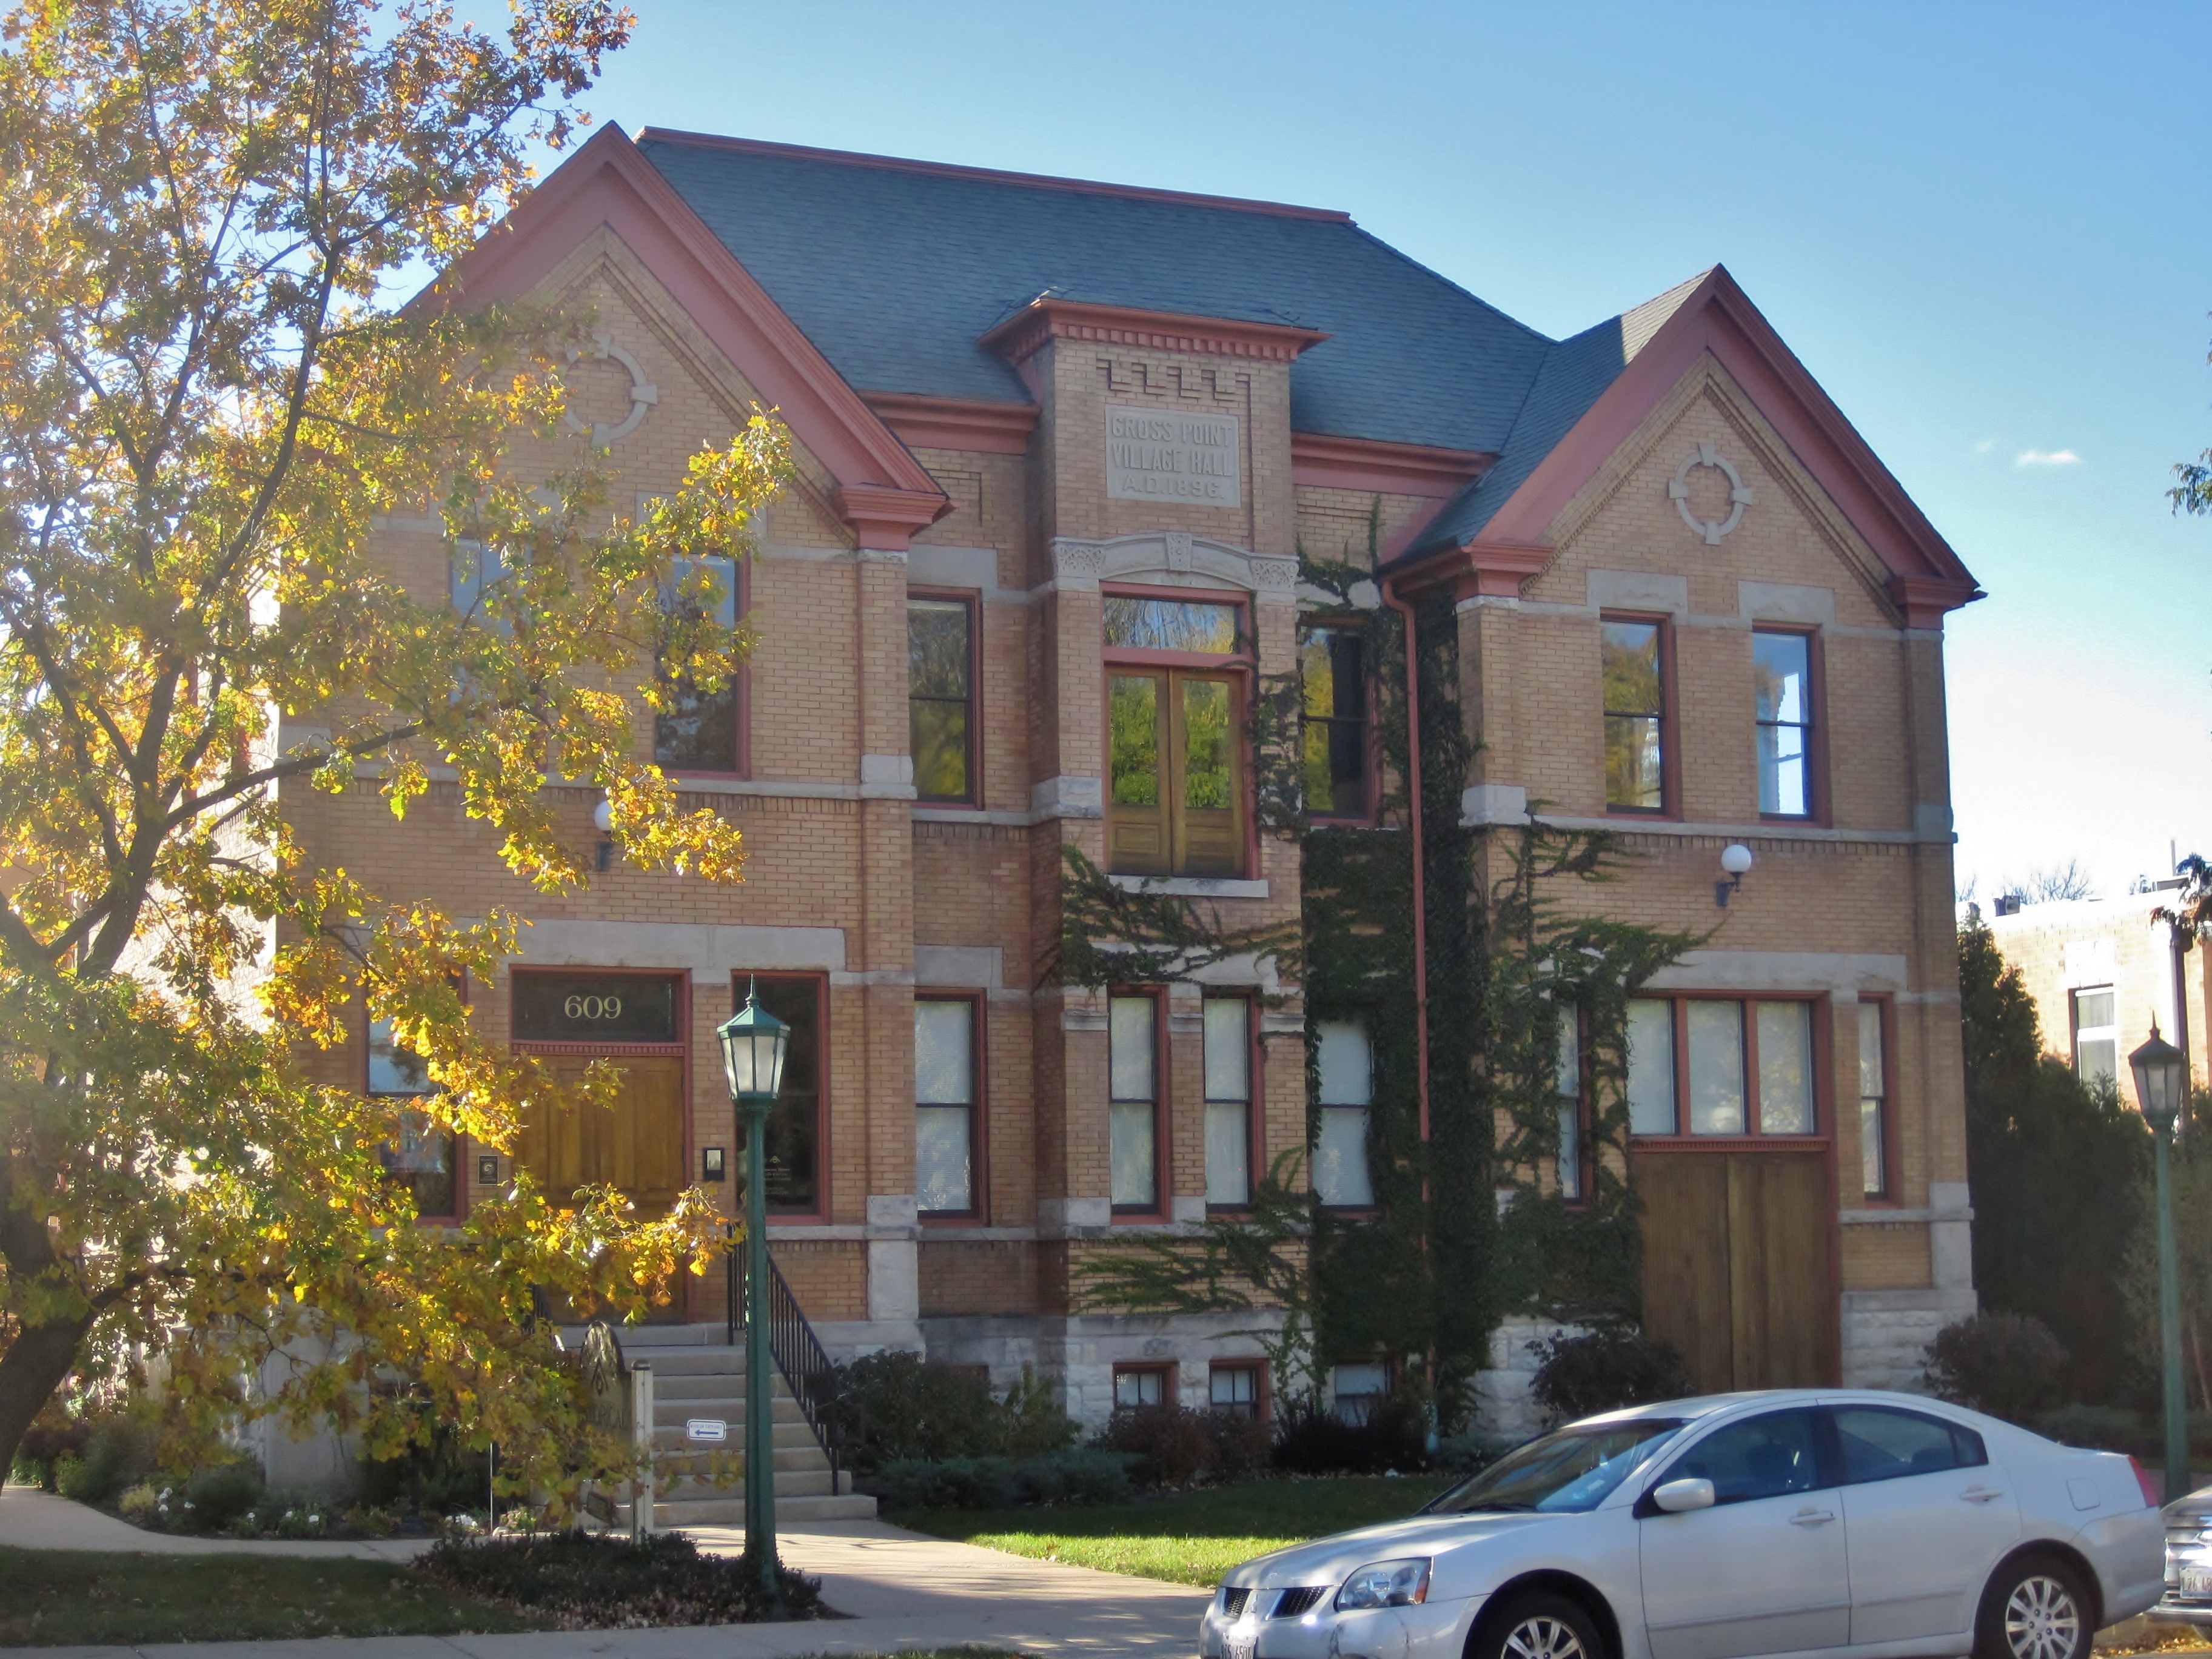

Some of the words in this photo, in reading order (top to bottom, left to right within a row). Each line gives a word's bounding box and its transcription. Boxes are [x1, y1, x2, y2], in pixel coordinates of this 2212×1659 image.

[1111, 417, 1172, 441] GROSS
[1181, 422, 1232, 447] POINT
[1111, 443, 1183, 473] VILLAGE
[1190, 449, 1232, 477] HALL
[564, 995, 622, 1019] 609
